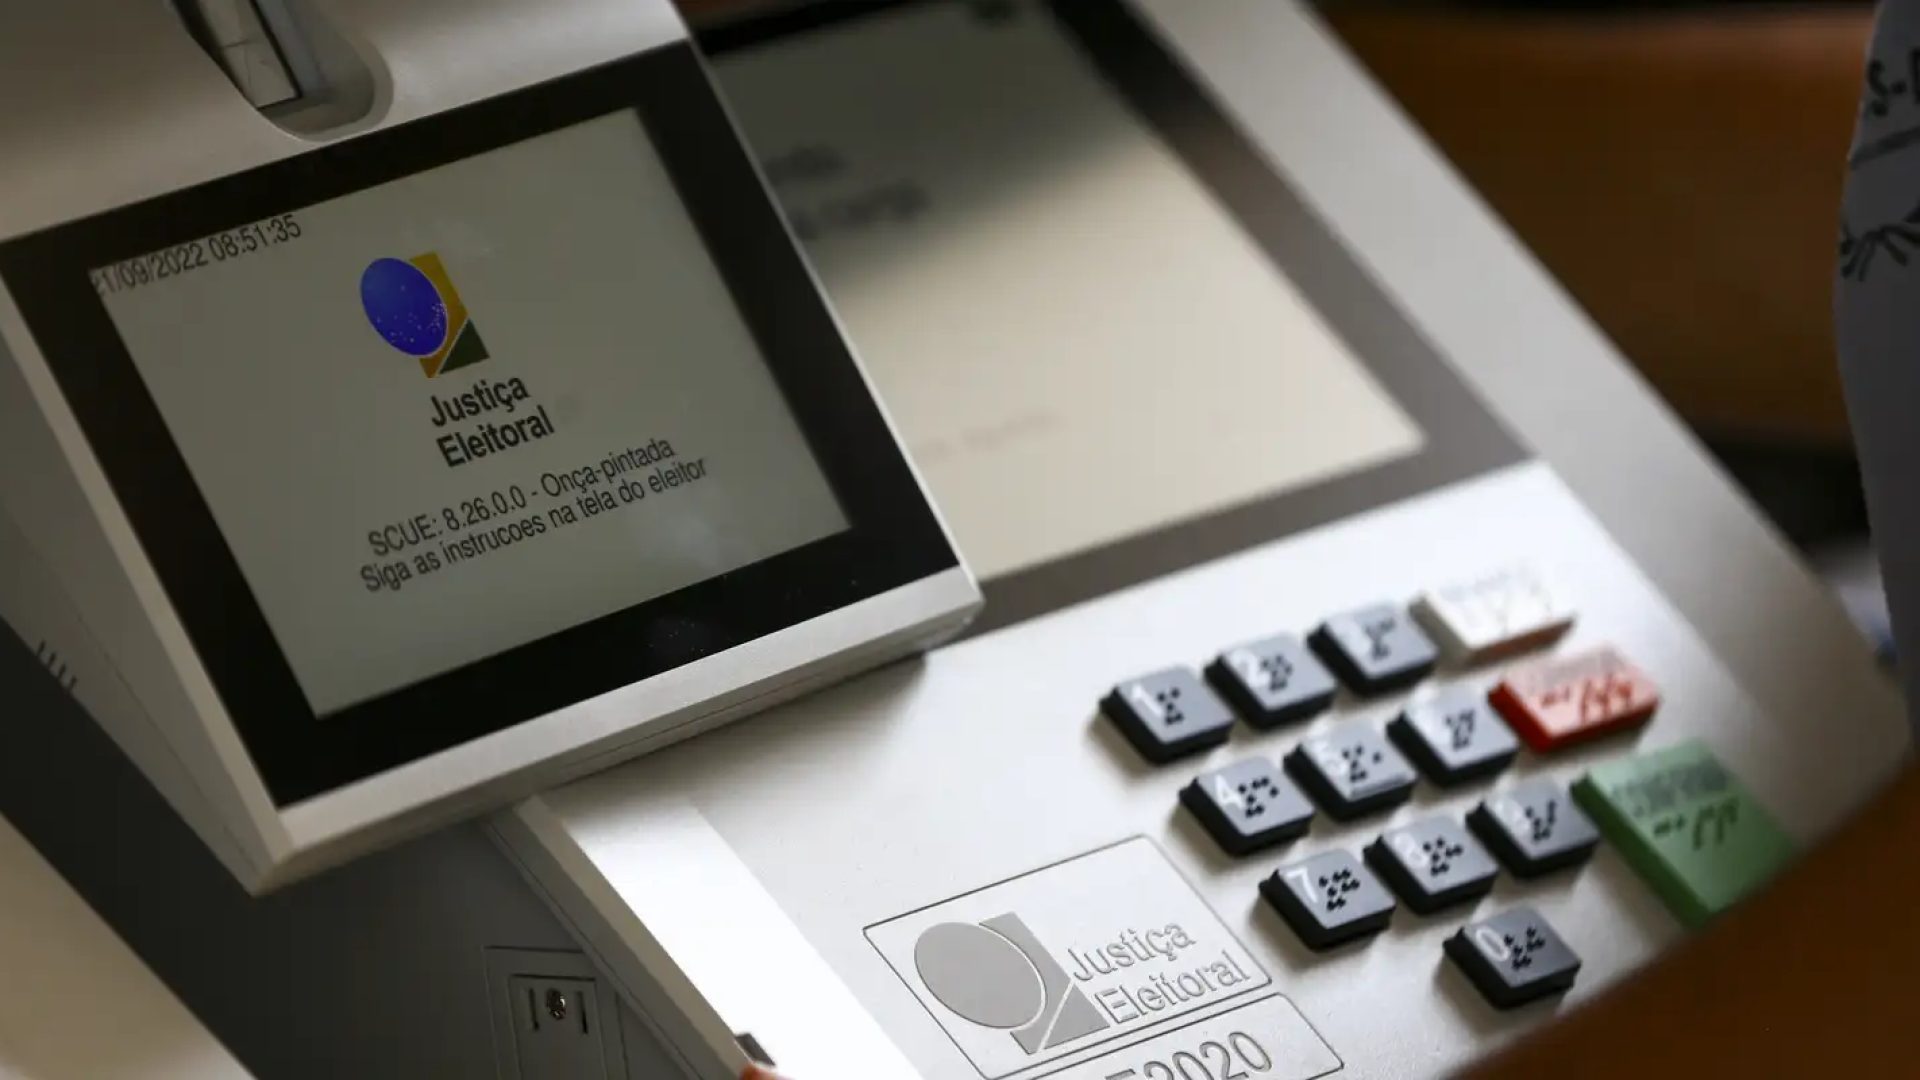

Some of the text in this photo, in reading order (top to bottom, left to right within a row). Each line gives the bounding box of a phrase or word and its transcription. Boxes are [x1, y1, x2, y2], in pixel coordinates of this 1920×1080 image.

[208, 214, 301, 261] 08:51:35
[431, 377, 530, 427] Justiça
[437, 405, 555, 467] Eleitoral
[368, 514, 444, 556] SCUE:
[442, 485, 527, 532] 8.26.0.0
[541, 438, 675, 497] Onça-pintada
[360, 458, 707, 591] Siga as instrucoes na tela do eleitor
[1131, 682, 1163, 717] 1
[1213, 774, 1245, 809] 4
[1285, 866, 1318, 903] 7
[1067, 923, 1197, 981] Justiça
[1474, 927, 1510, 963] 0
[1094, 949, 1251, 1025] Eleitoral
